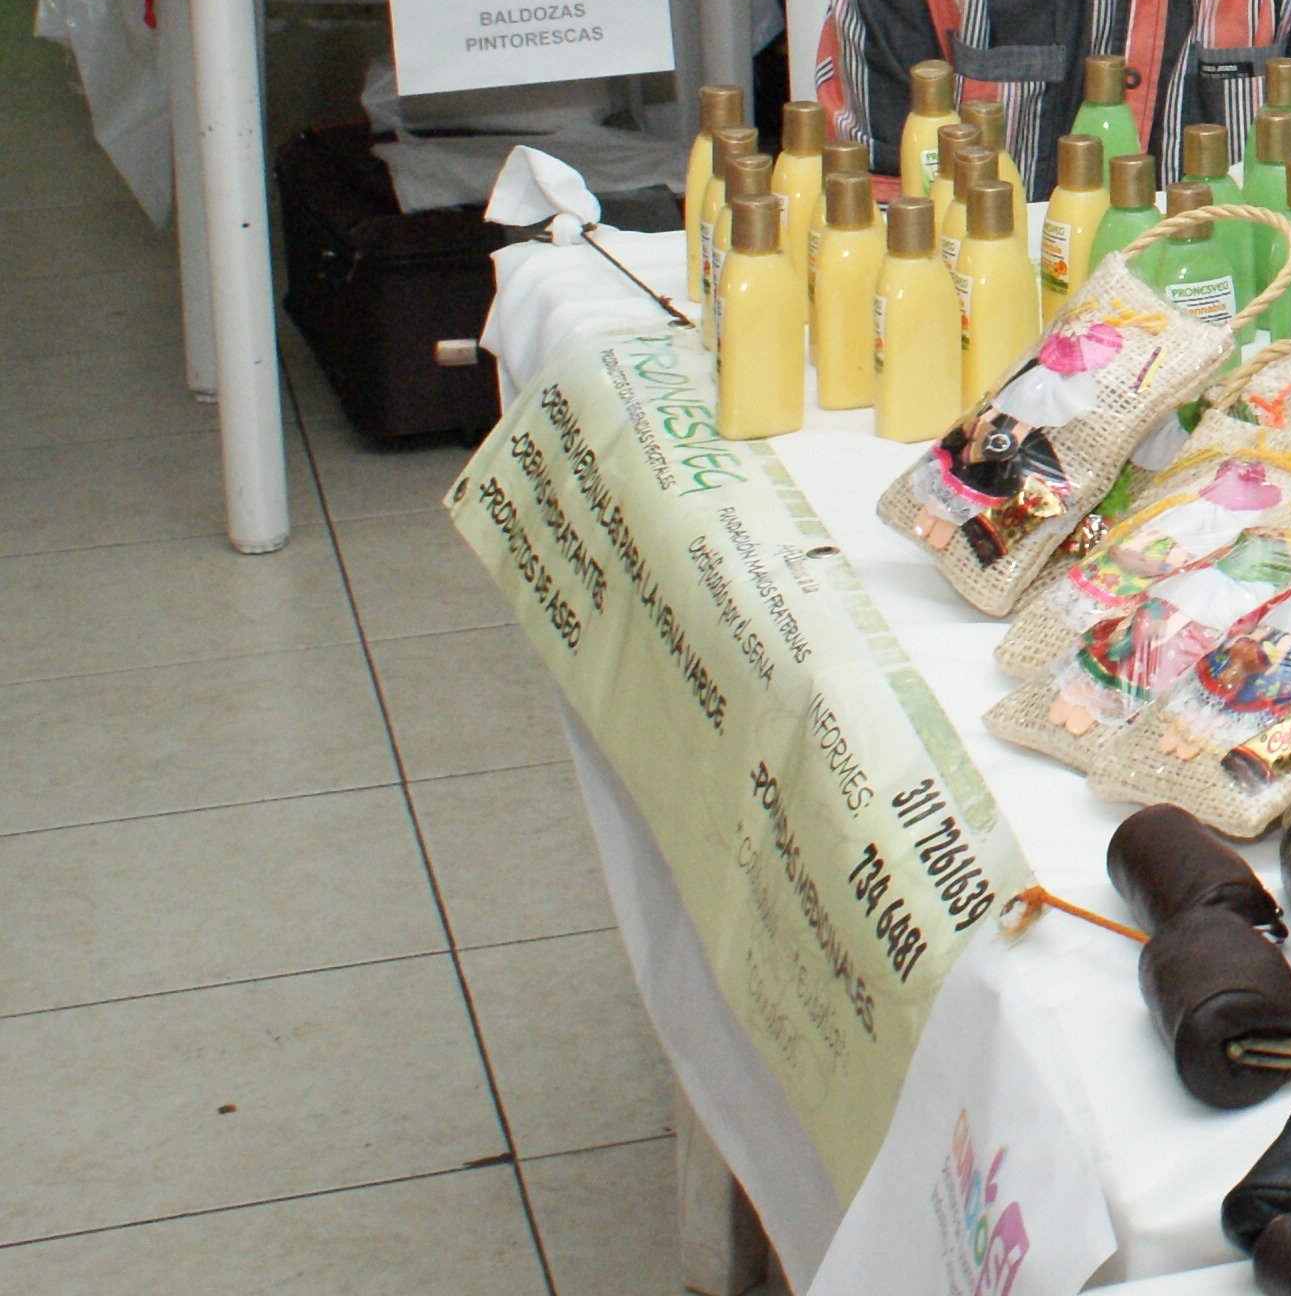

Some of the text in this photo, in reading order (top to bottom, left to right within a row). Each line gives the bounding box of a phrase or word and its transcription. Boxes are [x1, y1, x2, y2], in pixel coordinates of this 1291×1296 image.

[479, 3, 586, 27] BALDOZAS
[465, 26, 604, 52] PINTORESCAS
[892, 778, 947, 830] 311
